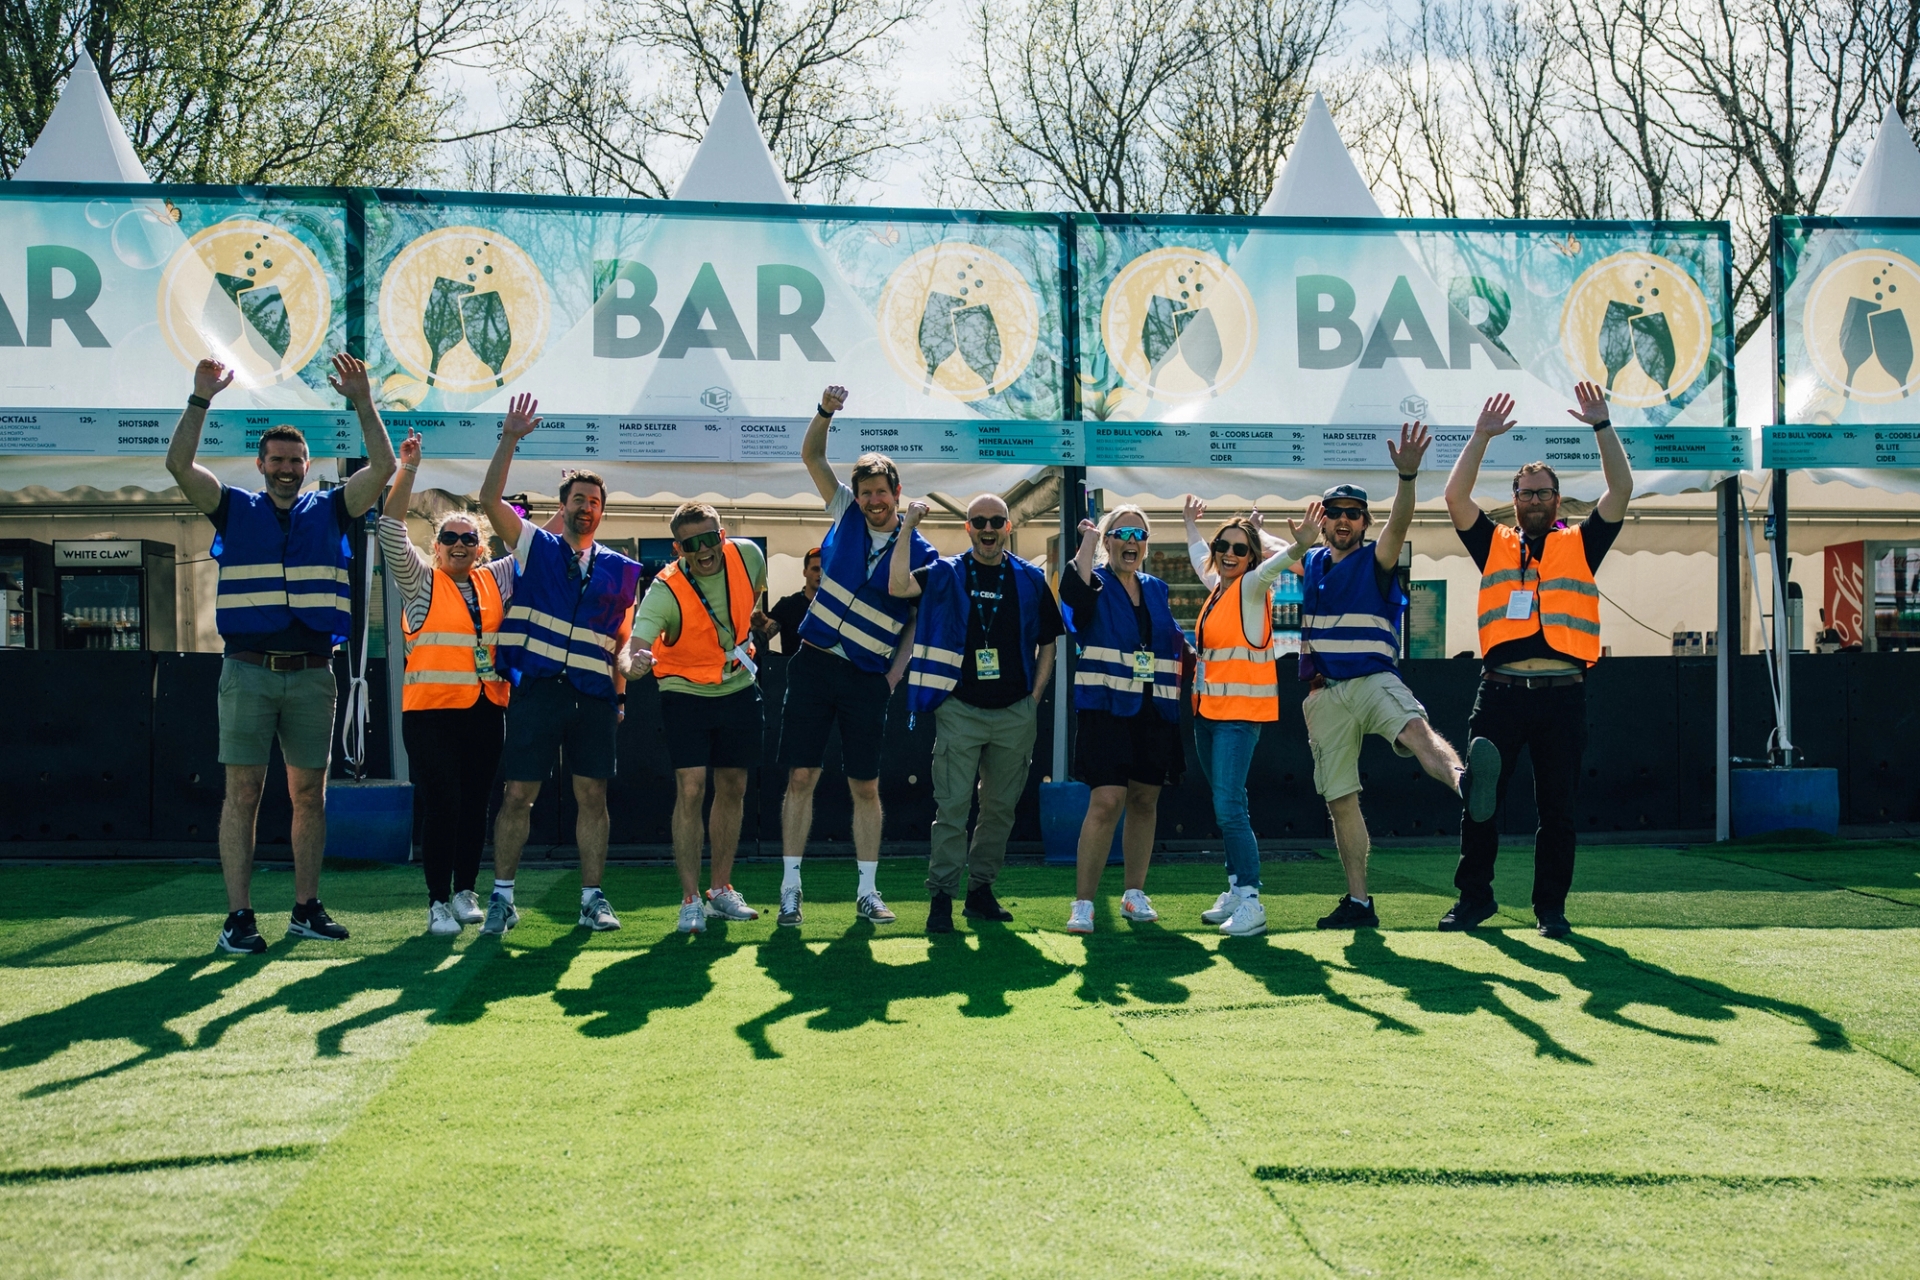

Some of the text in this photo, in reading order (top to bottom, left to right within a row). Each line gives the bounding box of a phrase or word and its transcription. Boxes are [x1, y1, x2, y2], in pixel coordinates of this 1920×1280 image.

[593, 258, 836, 362] BAR
[1296, 274, 1522, 370] BAR
[80, 416, 96, 424] 129,-
